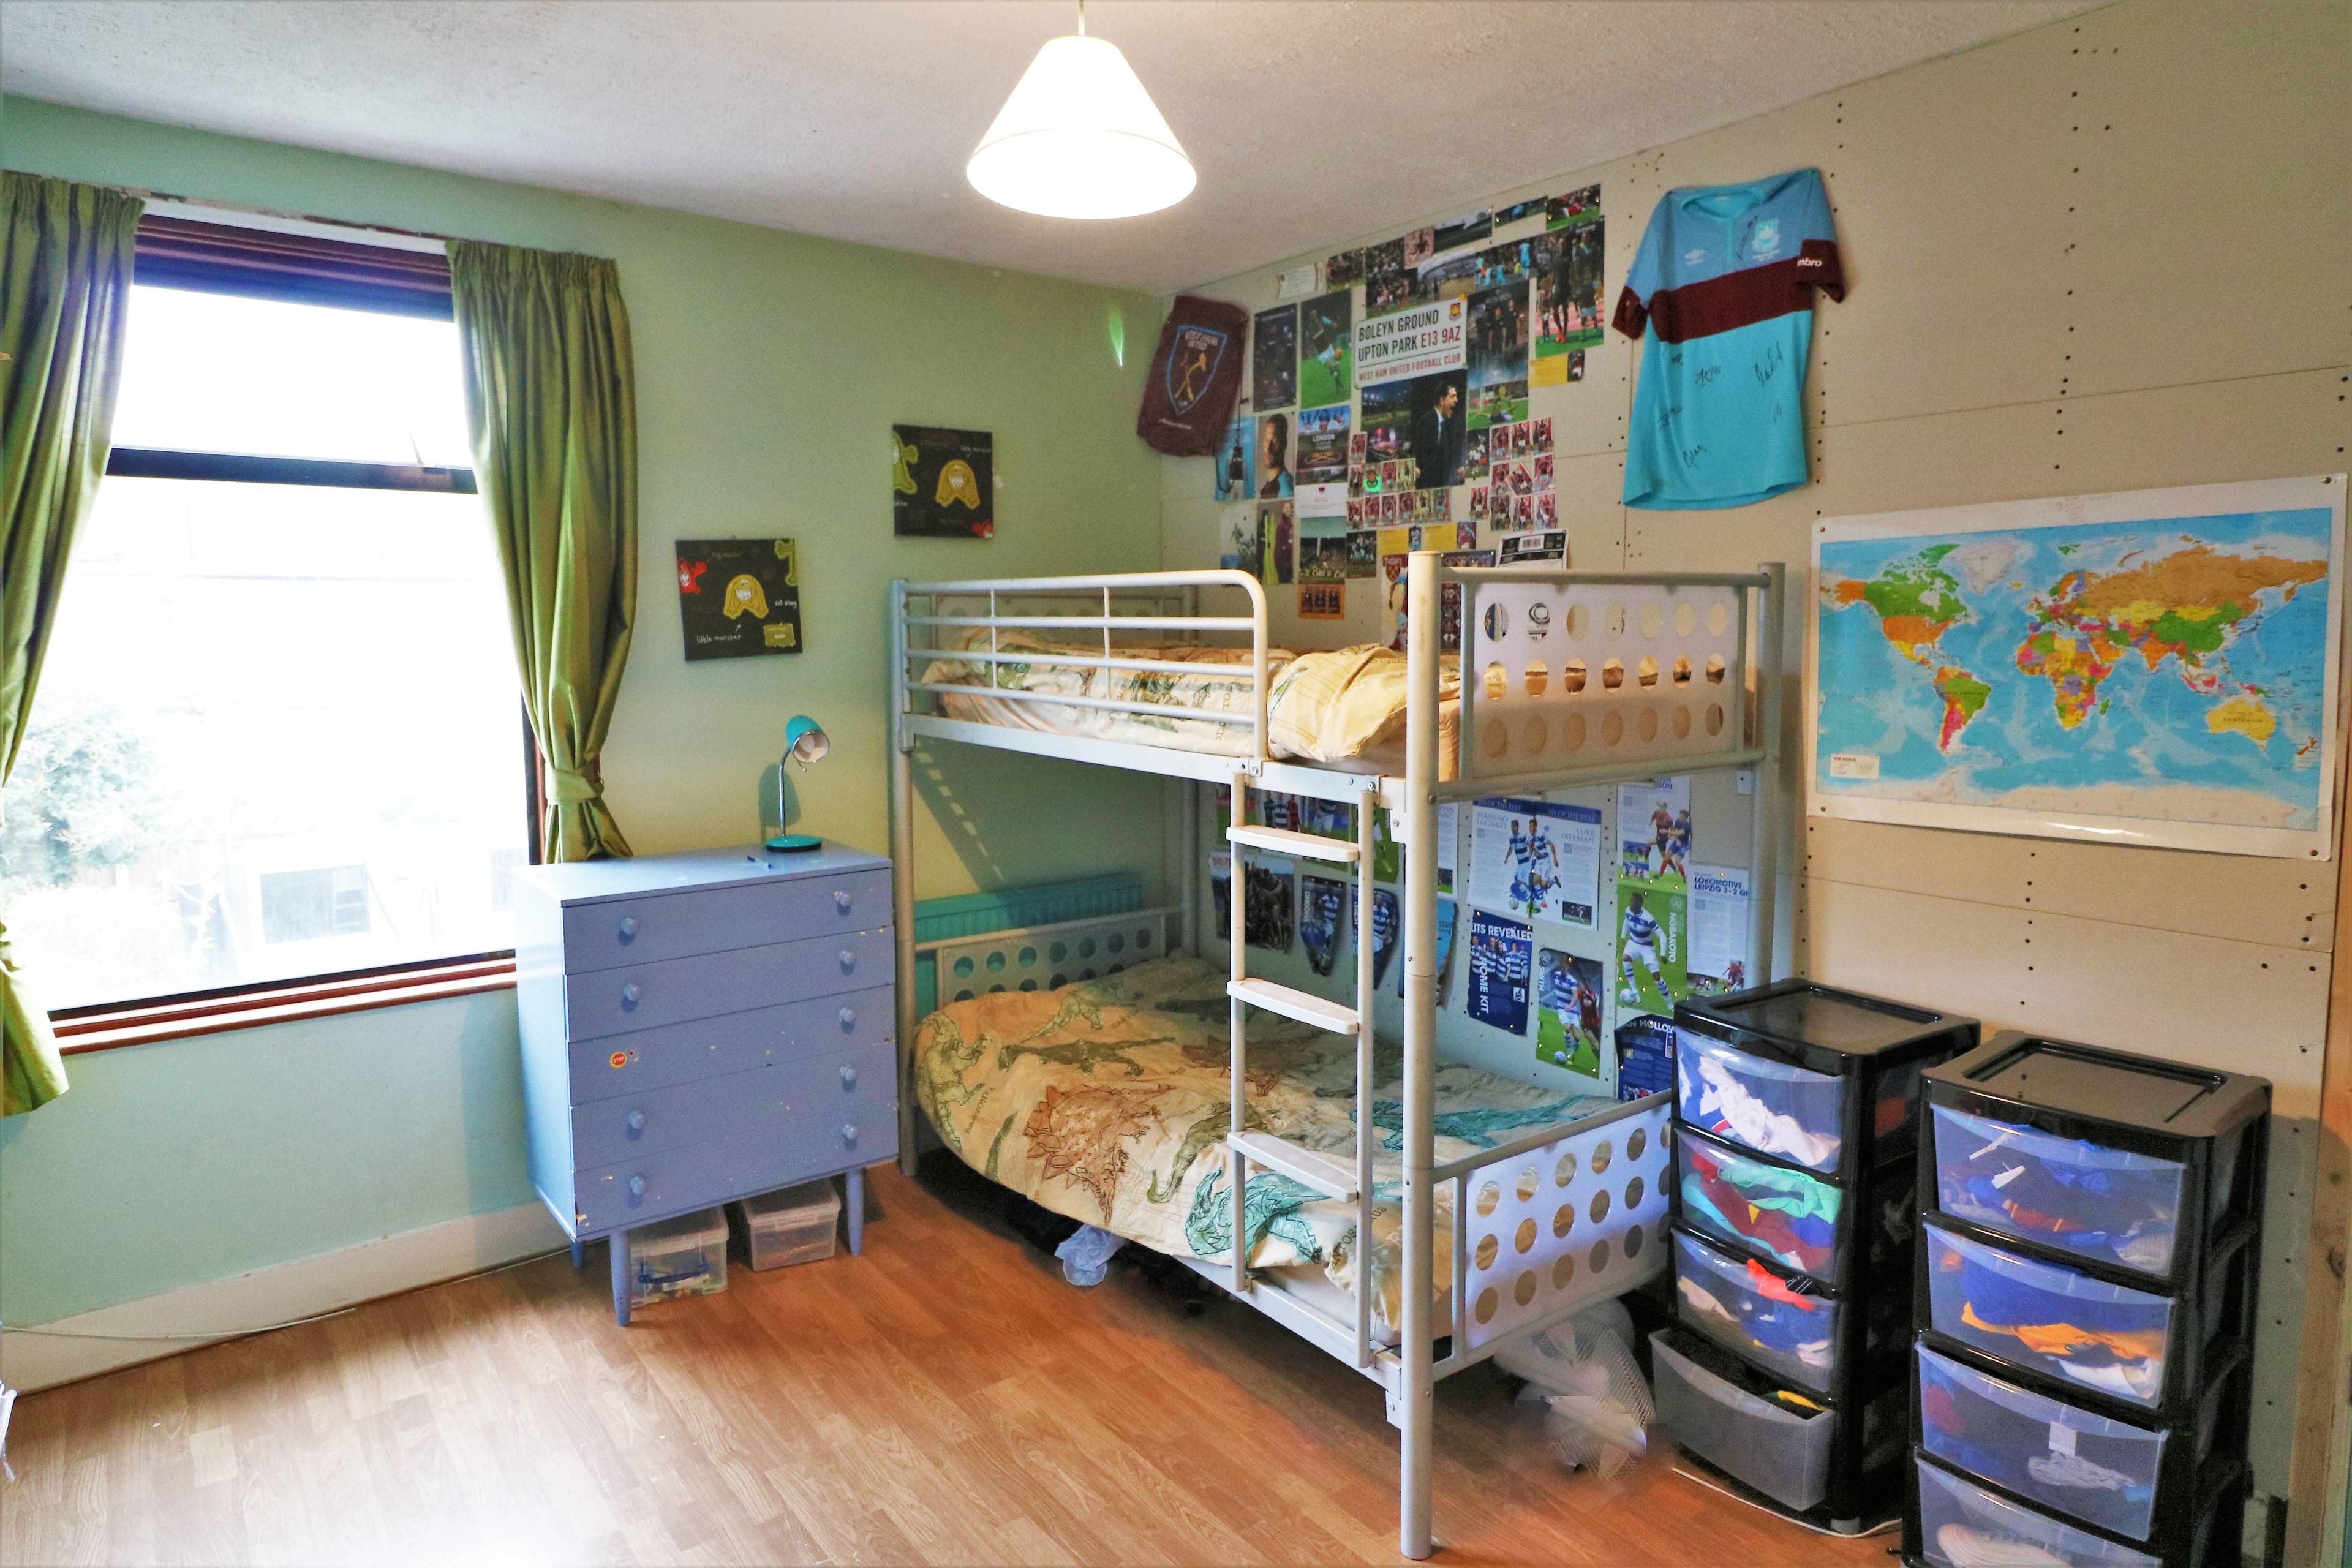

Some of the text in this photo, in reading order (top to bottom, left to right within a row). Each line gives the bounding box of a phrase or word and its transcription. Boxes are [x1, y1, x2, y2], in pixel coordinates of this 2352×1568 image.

[1359, 309, 1439, 341] BOLEYN GROUND
[1359, 325, 1461, 361] UPTON PARK E13 9AZ
[1358, 353, 1461, 381] WEST HAM UNITED FOOTBALL CLUB
[696, 634, 712, 644] little
[1694, 876, 1743, 889] LOKOMOTIVE
[1694, 883, 1721, 893] LEIPZIG
[1472, 922, 1532, 941] ITS REVEALED
[1479, 956, 1489, 1014] HOME KIT
